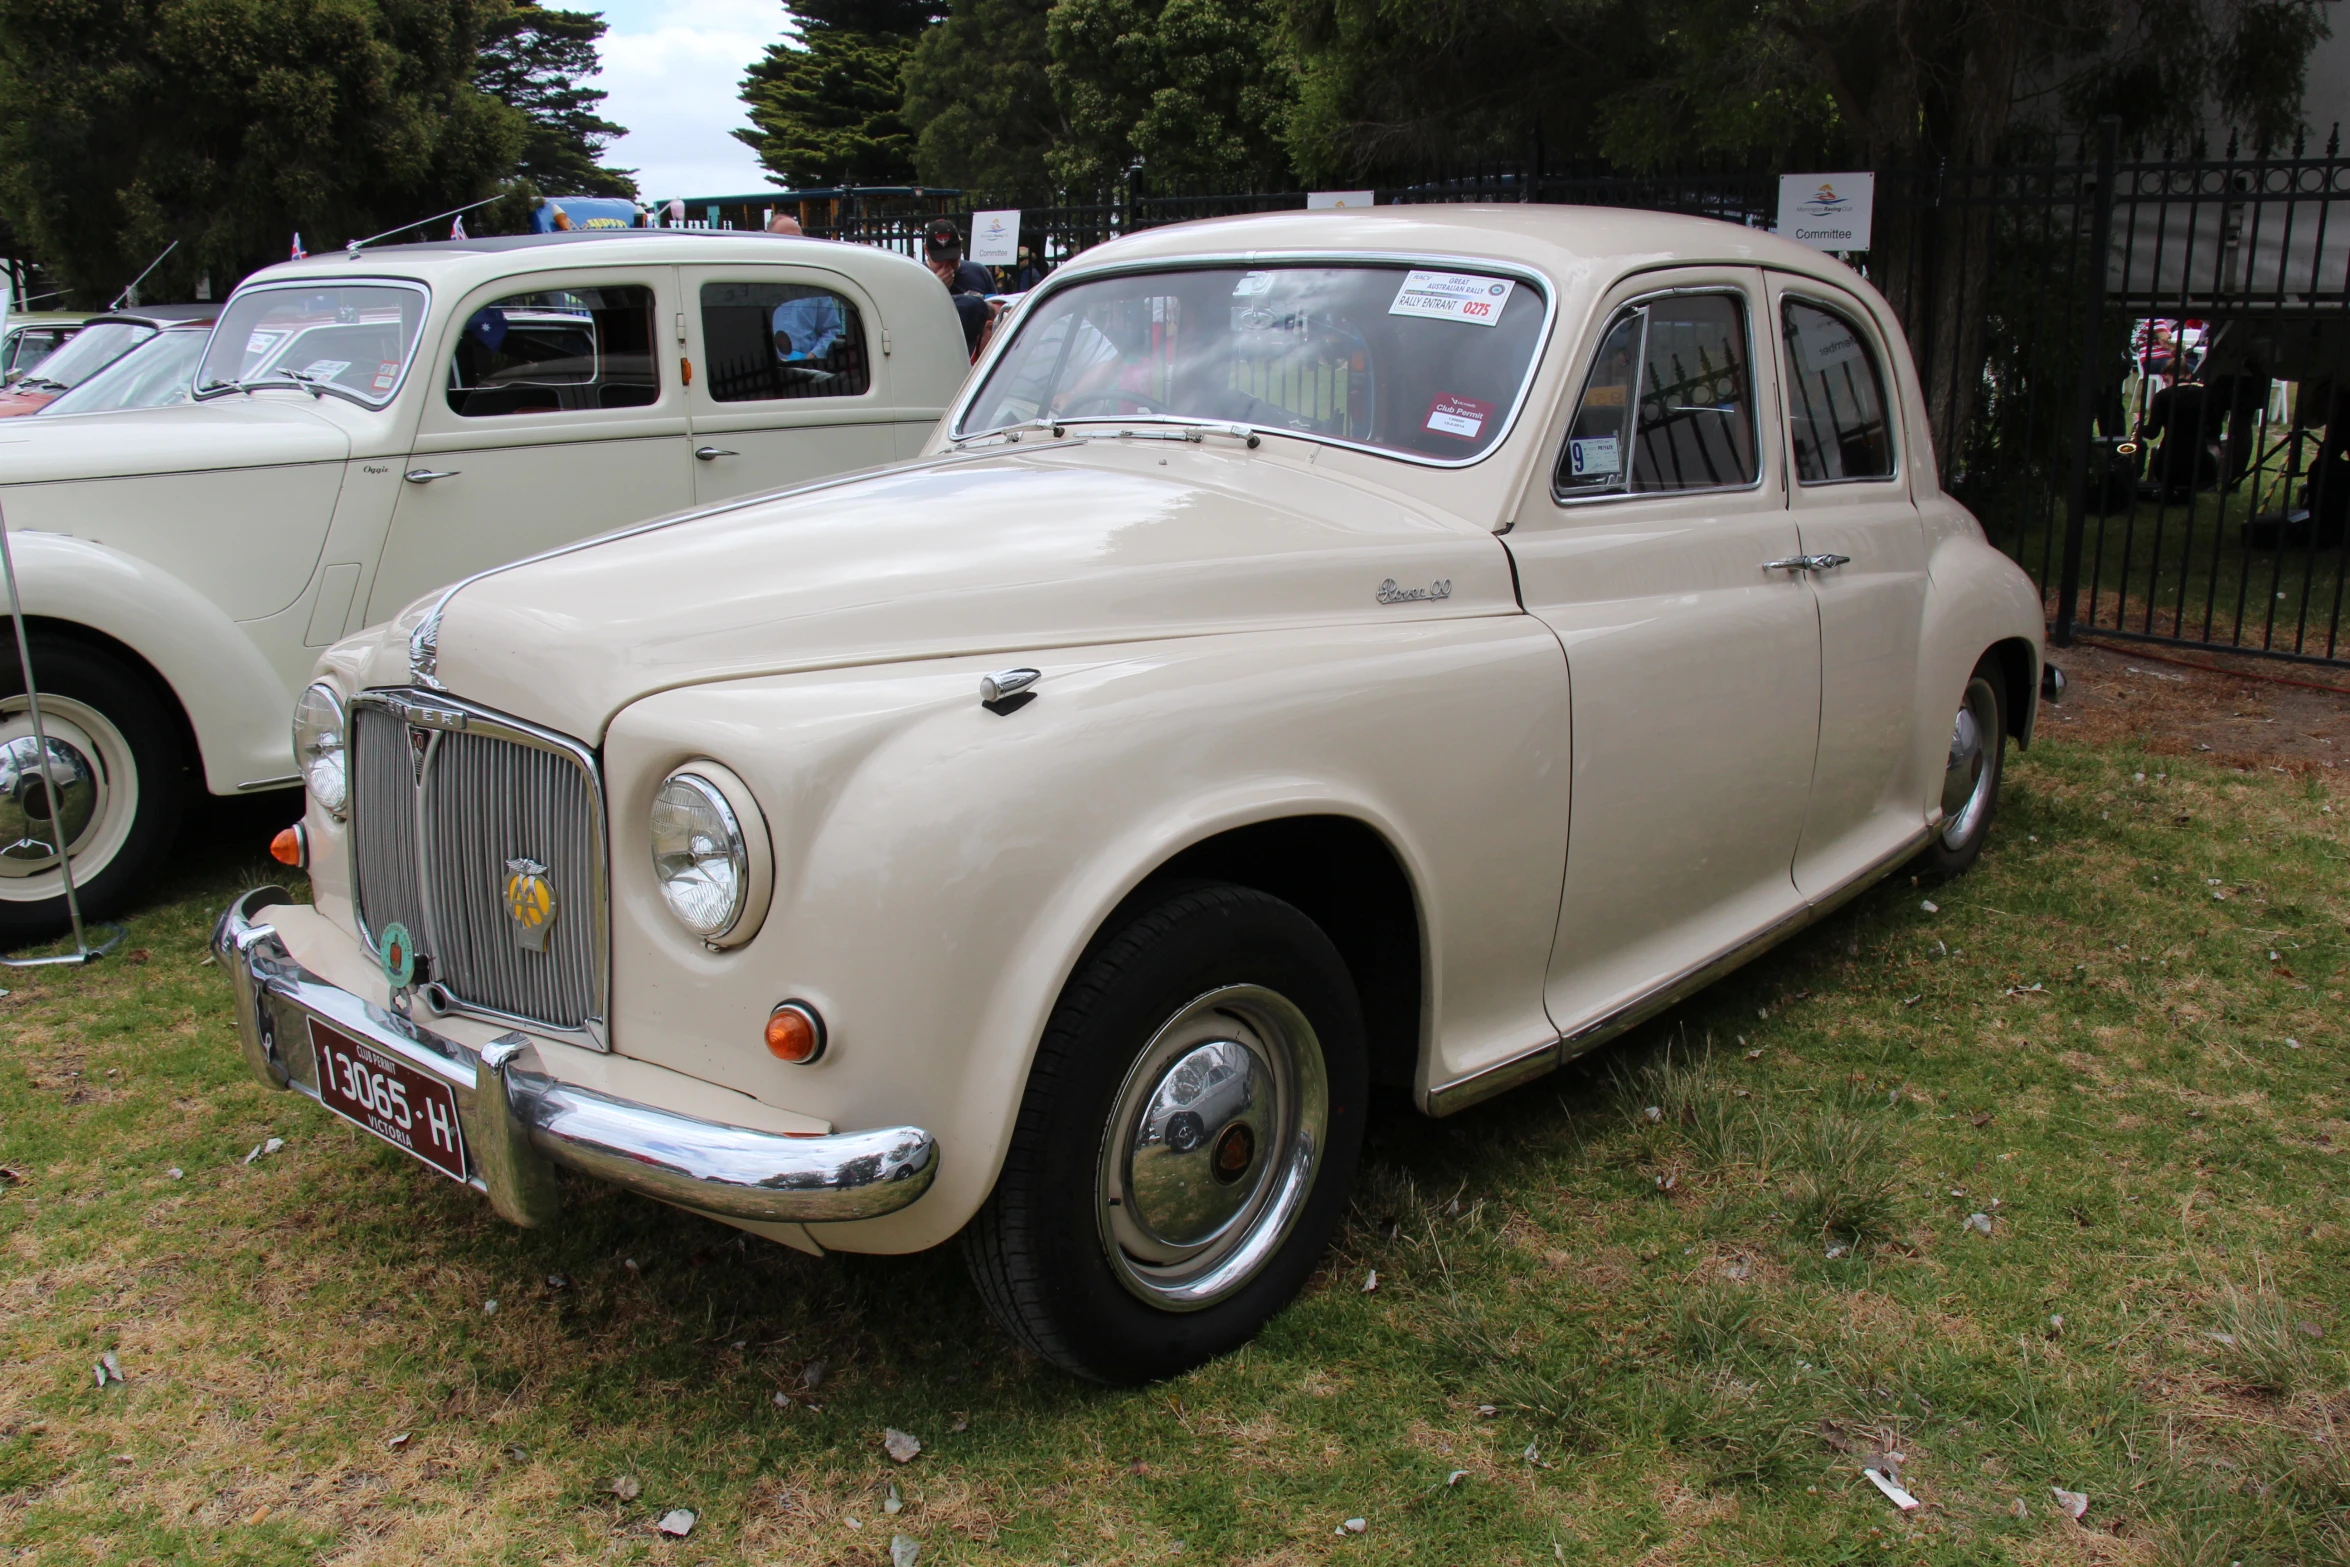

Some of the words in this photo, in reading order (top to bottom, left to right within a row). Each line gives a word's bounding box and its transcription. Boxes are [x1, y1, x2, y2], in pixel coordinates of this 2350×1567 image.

[1796, 229, 1852, 239] Committee
[979, 249, 1008, 257] Committee
[1427, 283, 1464, 292] AUSTRALIAN
[1399, 296, 1423, 307] RALLY
[1422, 298, 1457, 311] ENTRANT
[1463, 301, 1491, 316] 0275
[1436, 404, 1455, 413] Club
[1456, 408, 1484, 419] Permit
[1572, 442, 1584, 472] 9
[363, 465, 388, 474] Oggie
[1376, 578, 1427, 604] Rover
[1431, 578, 1452, 602] 90
[356, 1045, 373, 1063] CLUB
[373, 1055, 396, 1076] PERMIT
[368, 1114, 413, 1149] VICTORIA
